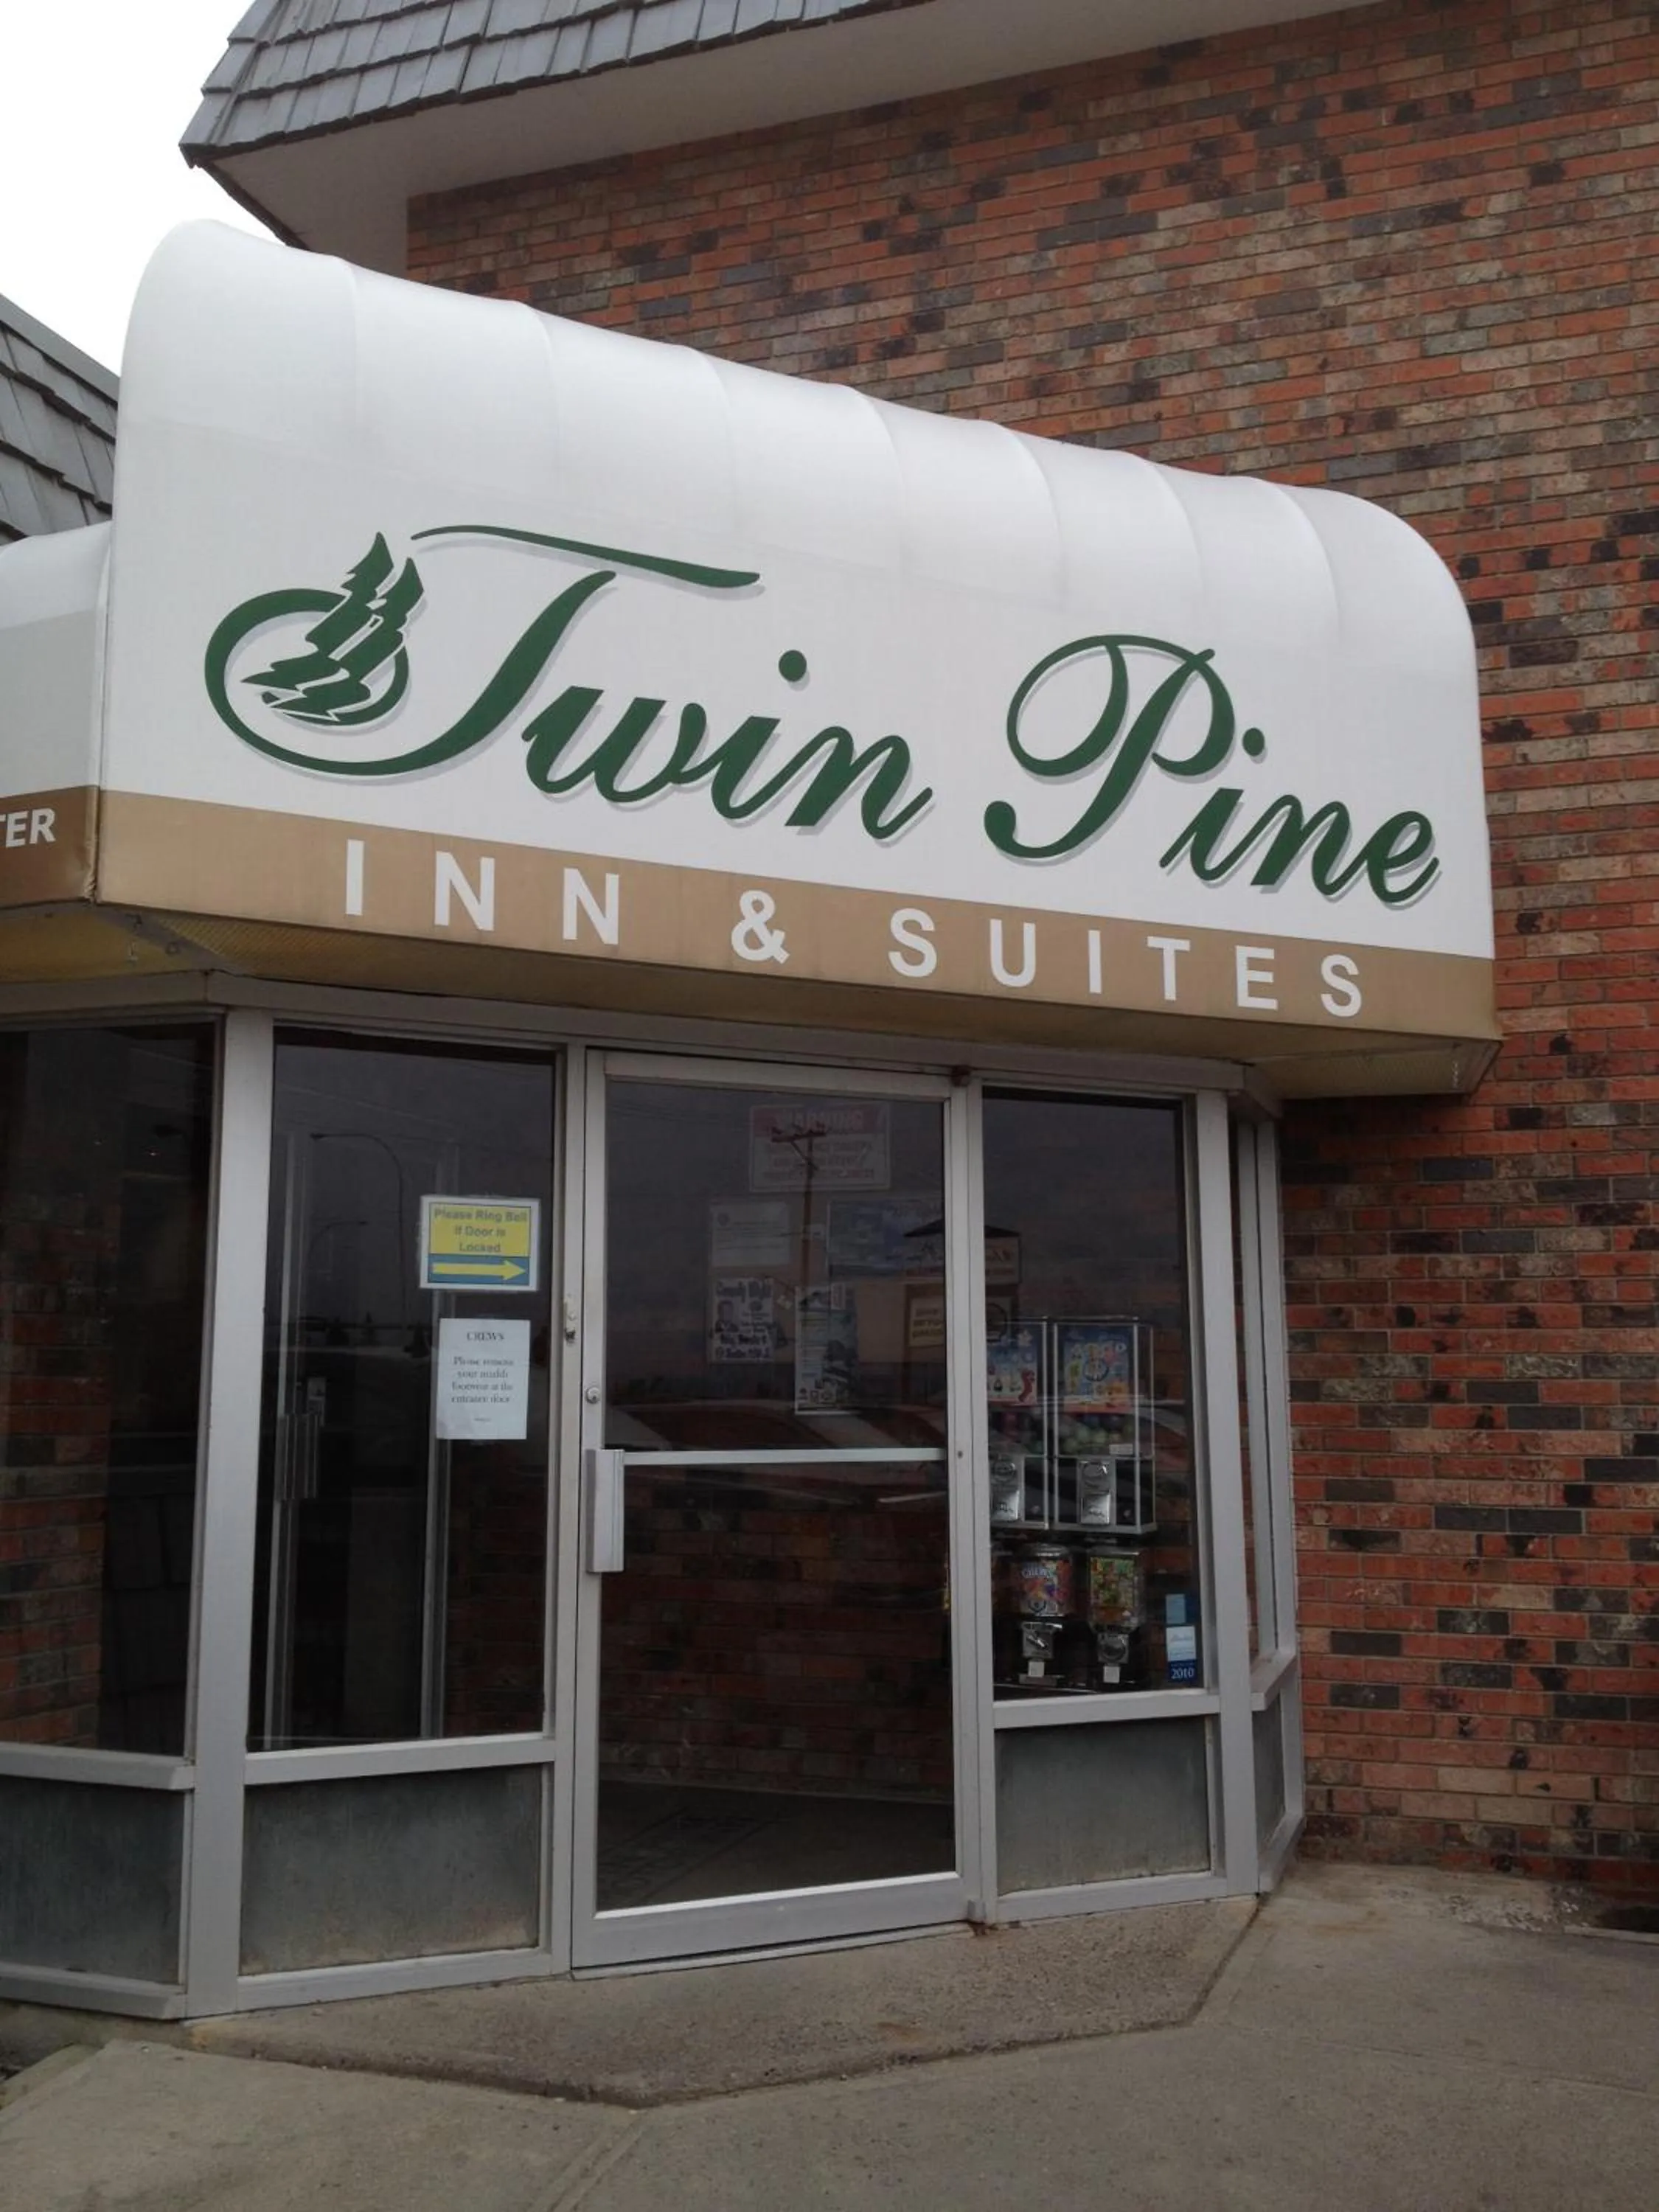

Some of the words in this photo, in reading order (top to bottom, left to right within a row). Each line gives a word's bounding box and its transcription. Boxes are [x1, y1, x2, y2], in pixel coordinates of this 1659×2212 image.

[205, 524, 933, 840] Twin
[983, 634, 1440, 904] Pine
[345, 839, 621, 946] INN
[731, 889, 789, 965] &
[887, 907, 1363, 1018] SUITES
[434, 1208, 473, 1220] Please
[475, 1209, 503, 1223] Ring
[504, 1211, 528, 1222] Bell
[465, 1225, 494, 1237] Door
[459, 1241, 502, 1253] Locked
[466, 1332, 506, 1341] CREWS
[1170, 1667, 1195, 1680] 2010
